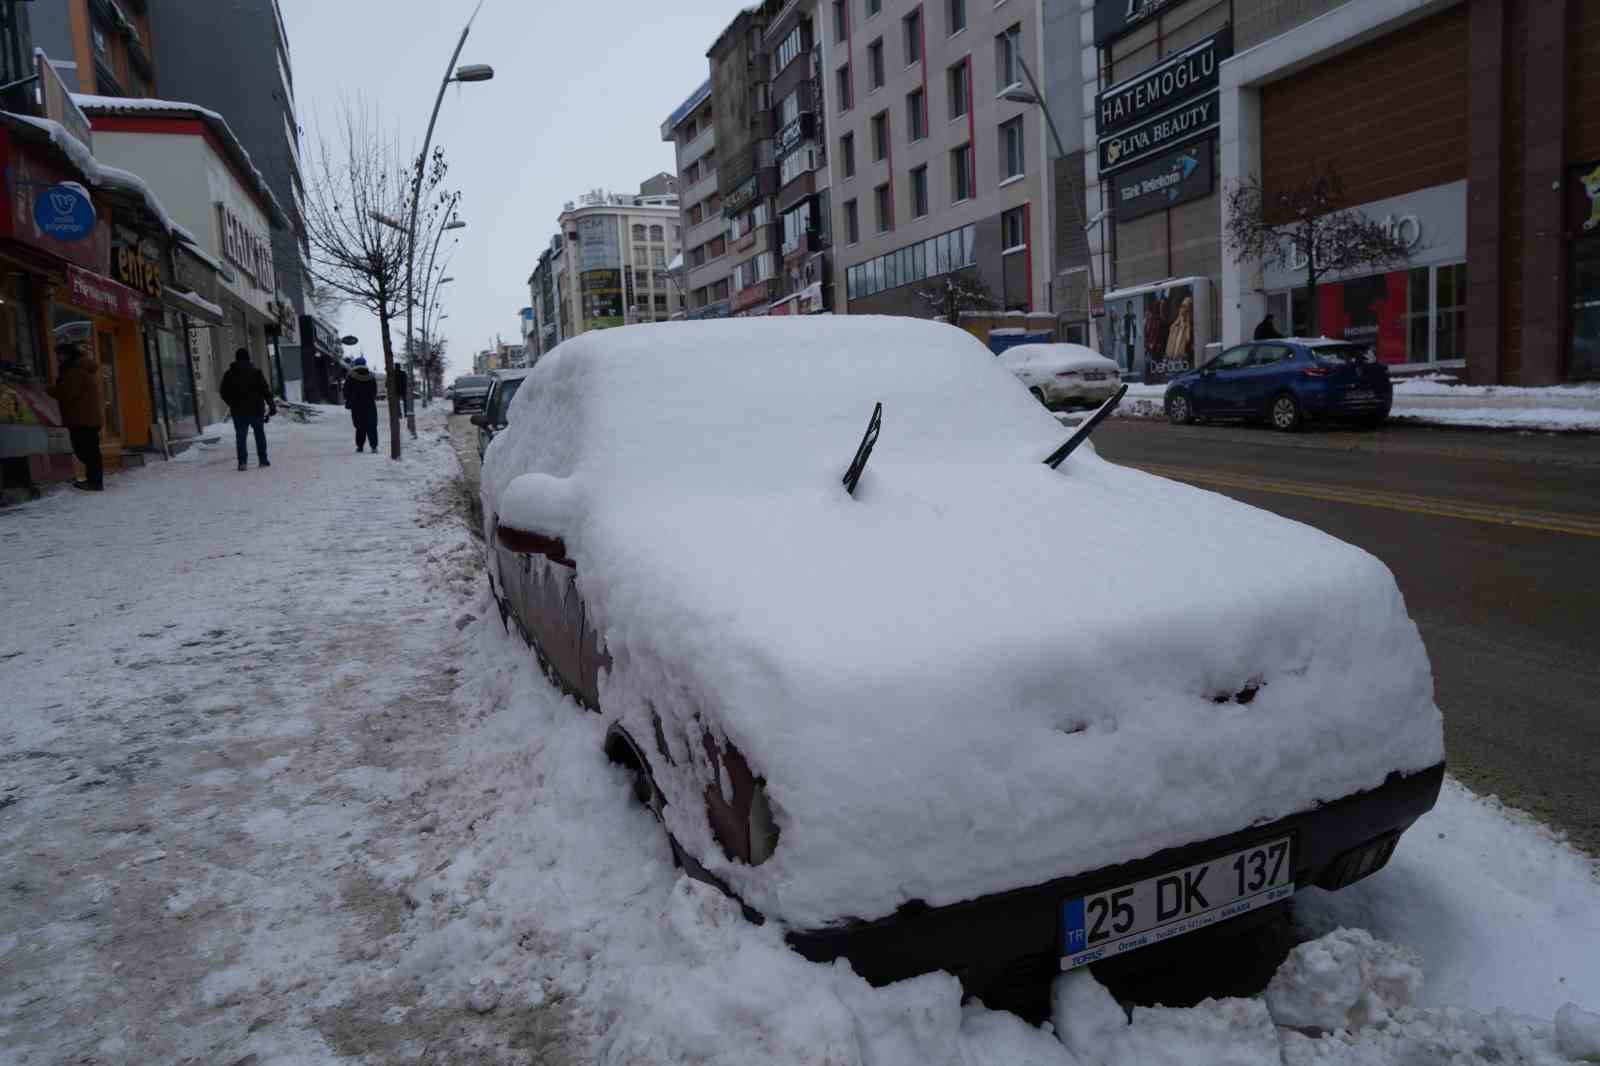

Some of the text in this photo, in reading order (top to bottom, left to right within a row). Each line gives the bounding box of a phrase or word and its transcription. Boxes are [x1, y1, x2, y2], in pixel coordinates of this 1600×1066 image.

[1152, 103, 1211, 142] BEAUTY
[1087, 888, 1134, 943] 25
[1157, 866, 1209, 922] DK
[1233, 841, 1288, 896] 137
[1066, 928, 1084, 946] TR
